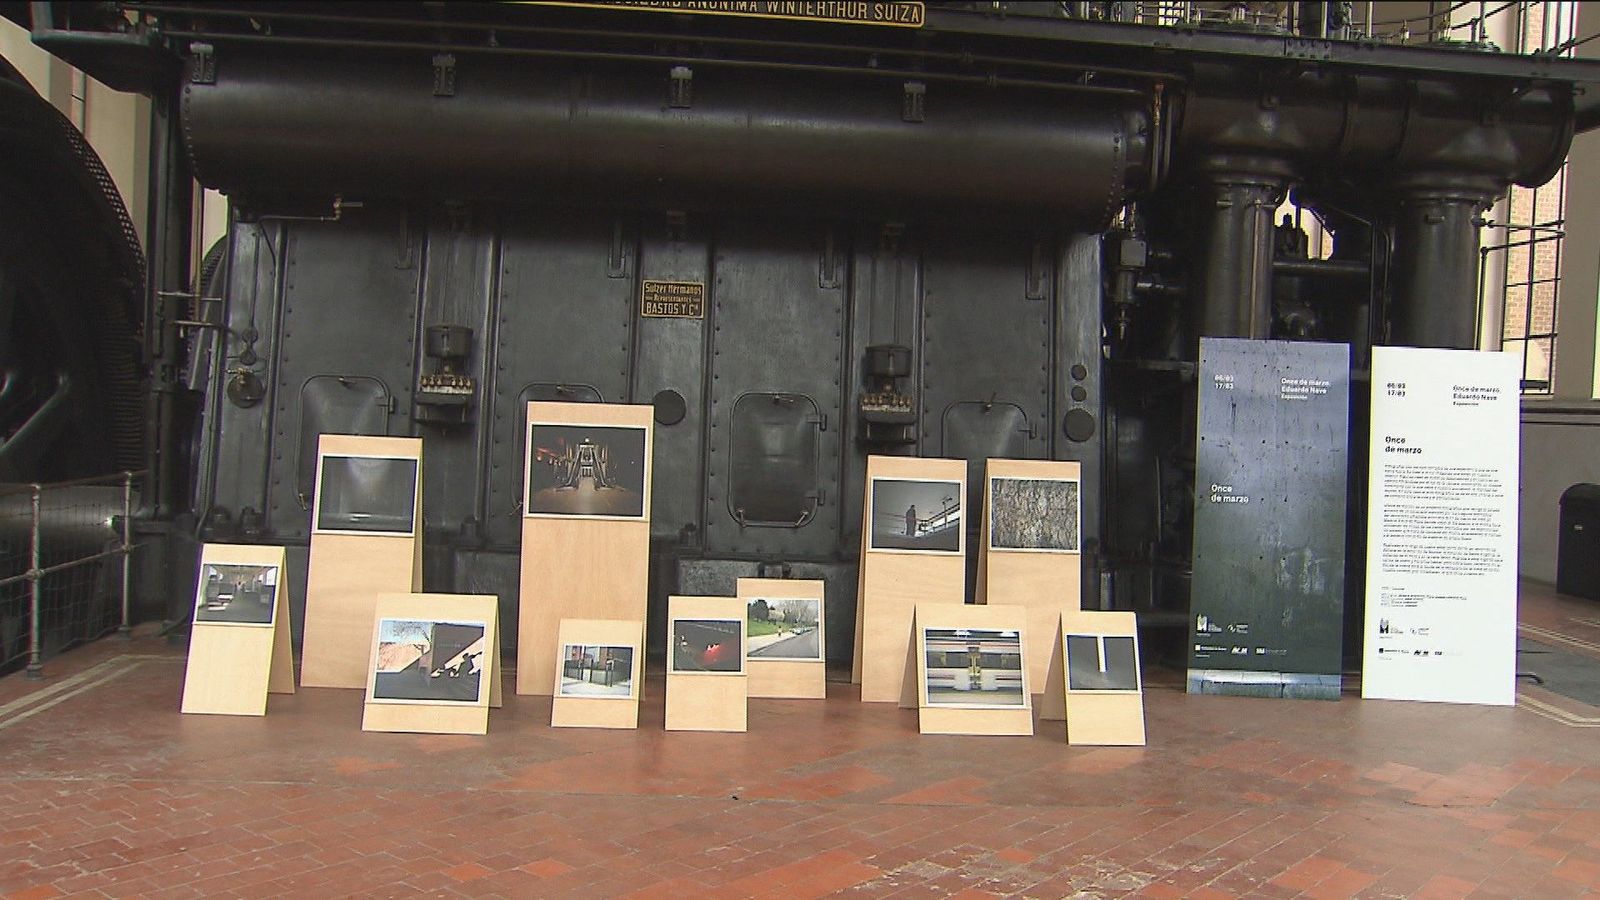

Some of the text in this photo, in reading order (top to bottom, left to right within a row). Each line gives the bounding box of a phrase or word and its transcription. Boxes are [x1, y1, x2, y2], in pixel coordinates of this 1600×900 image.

[767, 1, 867, 19] WINTERTHUR
[874, 4, 920, 23] SUIZA
[646, 302, 679, 314] BASTOS
[681, 303, 687, 315] Y
[1385, 435, 1406, 444] Once
[1384, 445, 1423, 454] de marzo
[1211, 483, 1233, 492] Once
[1211, 493, 1249, 504] de marzo
